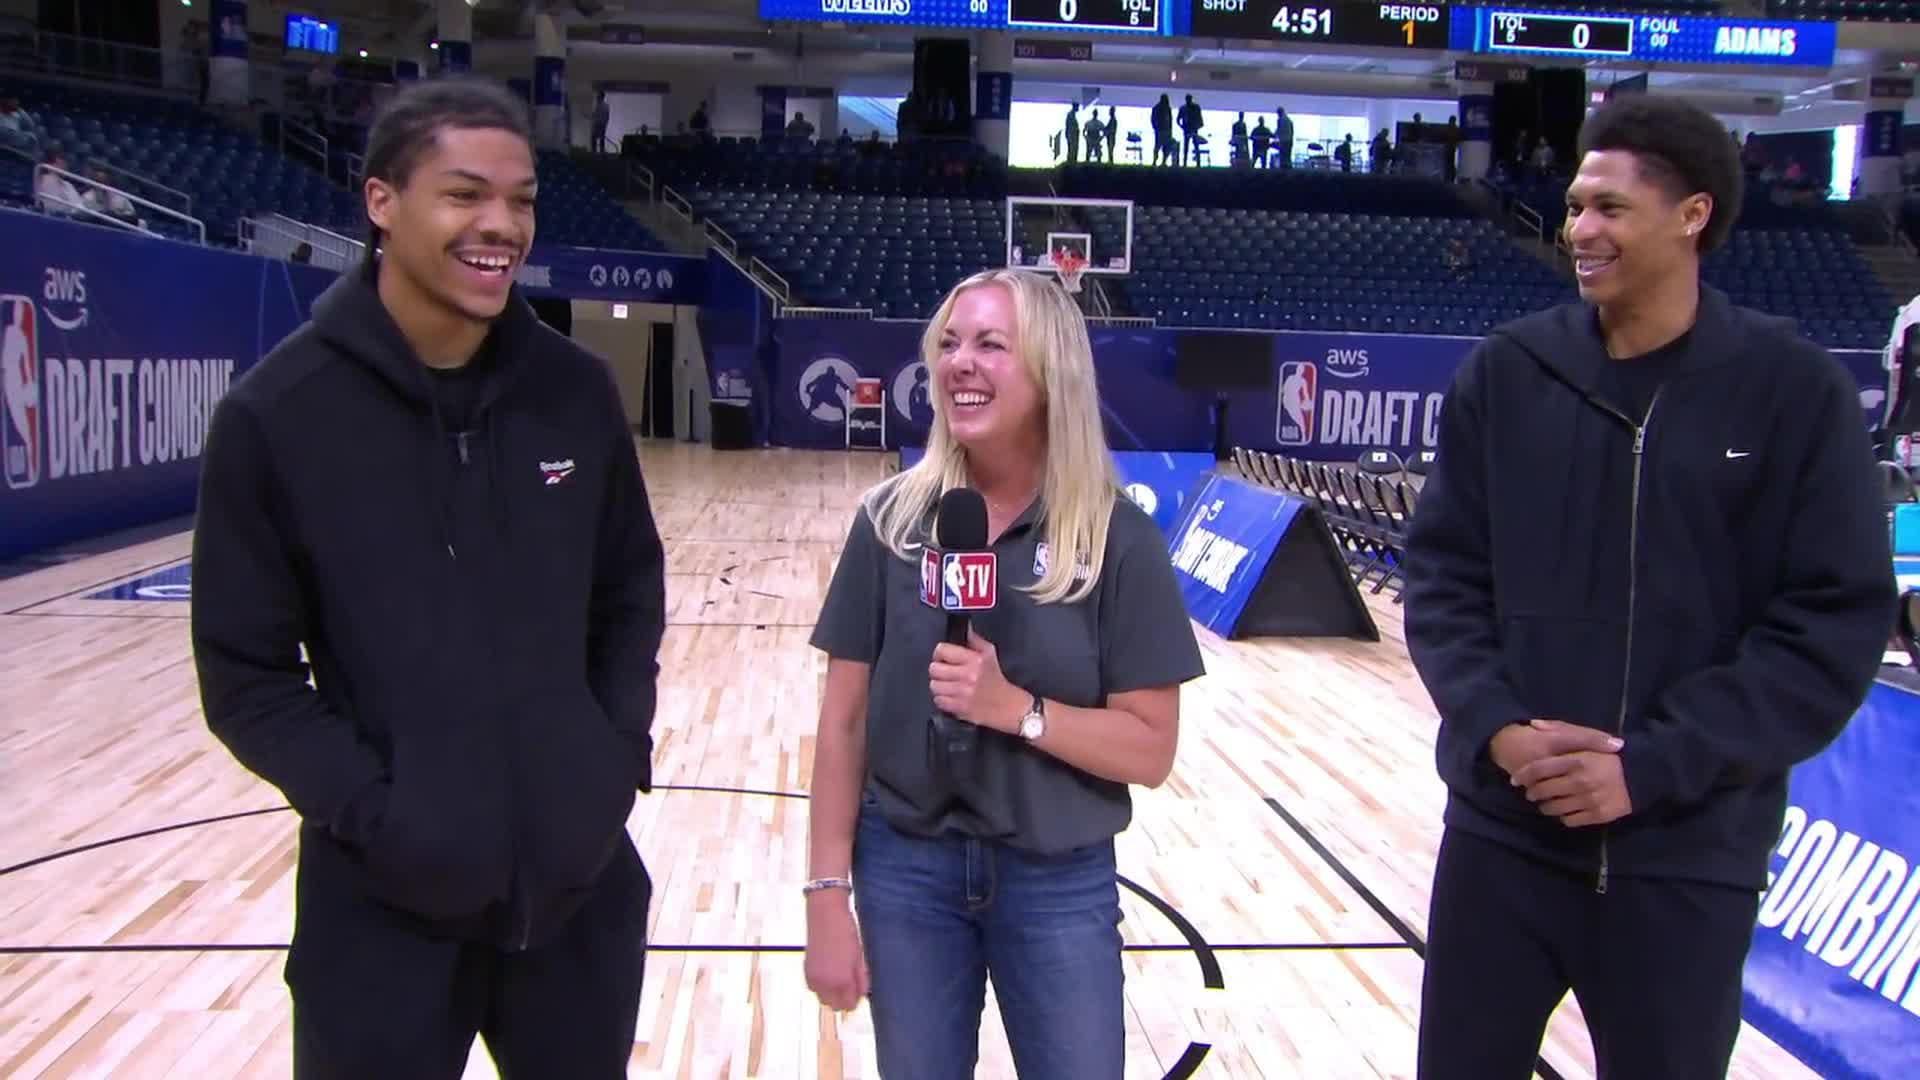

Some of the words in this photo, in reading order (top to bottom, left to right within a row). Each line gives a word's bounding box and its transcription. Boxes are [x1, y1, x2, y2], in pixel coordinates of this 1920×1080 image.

[1059, 0, 1077, 22] 0
[1121, 0, 1152, 12] TOL
[1203, 0, 1247, 11] SHOT
[1380, 5, 1439, 21] PERIOD
[1272, 6, 1332, 35] 4:51
[1401, 19, 1415, 45] 1
[1498, 16, 1528, 31] TOL
[1639, 18, 1680, 33] FOUL
[1573, 23, 1590, 49] 0
[1650, 33, 1668, 48] 00
[1713, 26, 1797, 56] ADAMS
[44, 266, 86, 303] aws
[1326, 348, 1369, 365] aws
[45, 358, 134, 479] DRAFT
[138, 358, 234, 465] COMBIN
[1319, 389, 1420, 446] DRAFT
[965, 563, 991, 599] TV
[1758, 805, 1920, 1017] OMBIN
